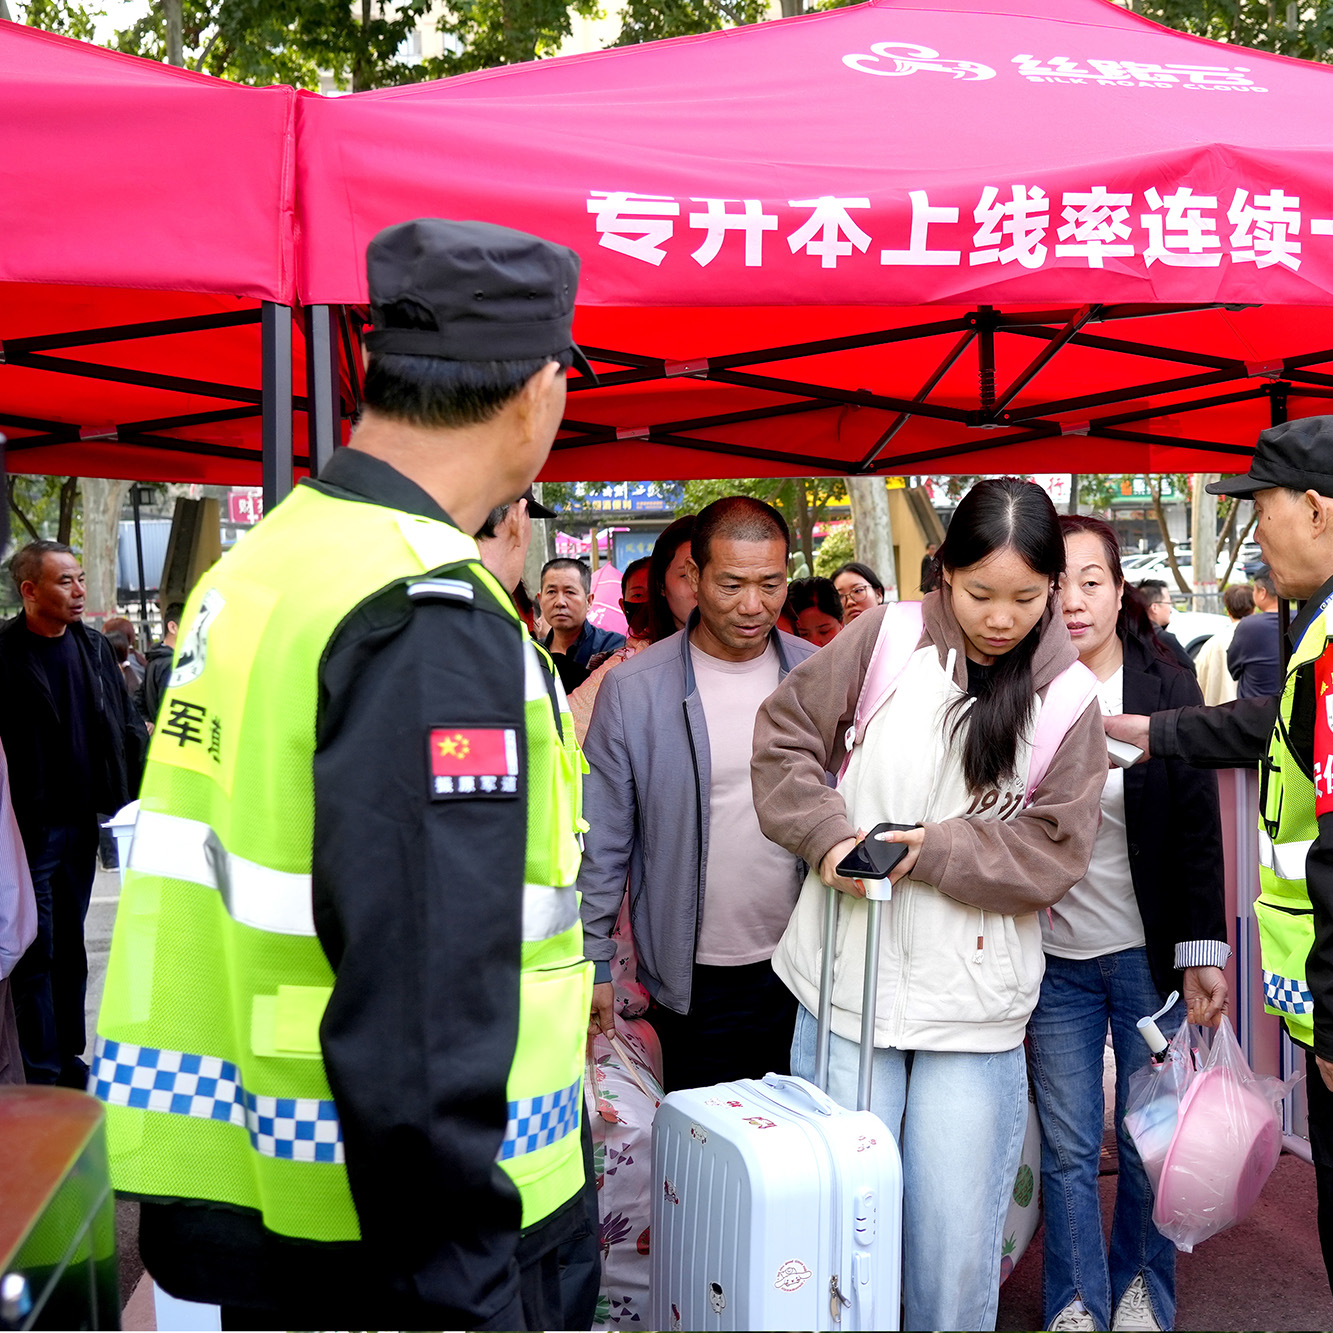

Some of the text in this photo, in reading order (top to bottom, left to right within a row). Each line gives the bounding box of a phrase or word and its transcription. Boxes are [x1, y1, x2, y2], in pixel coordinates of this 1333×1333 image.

[1025, 75, 1270, 94] SILK ROAD CLOUD
